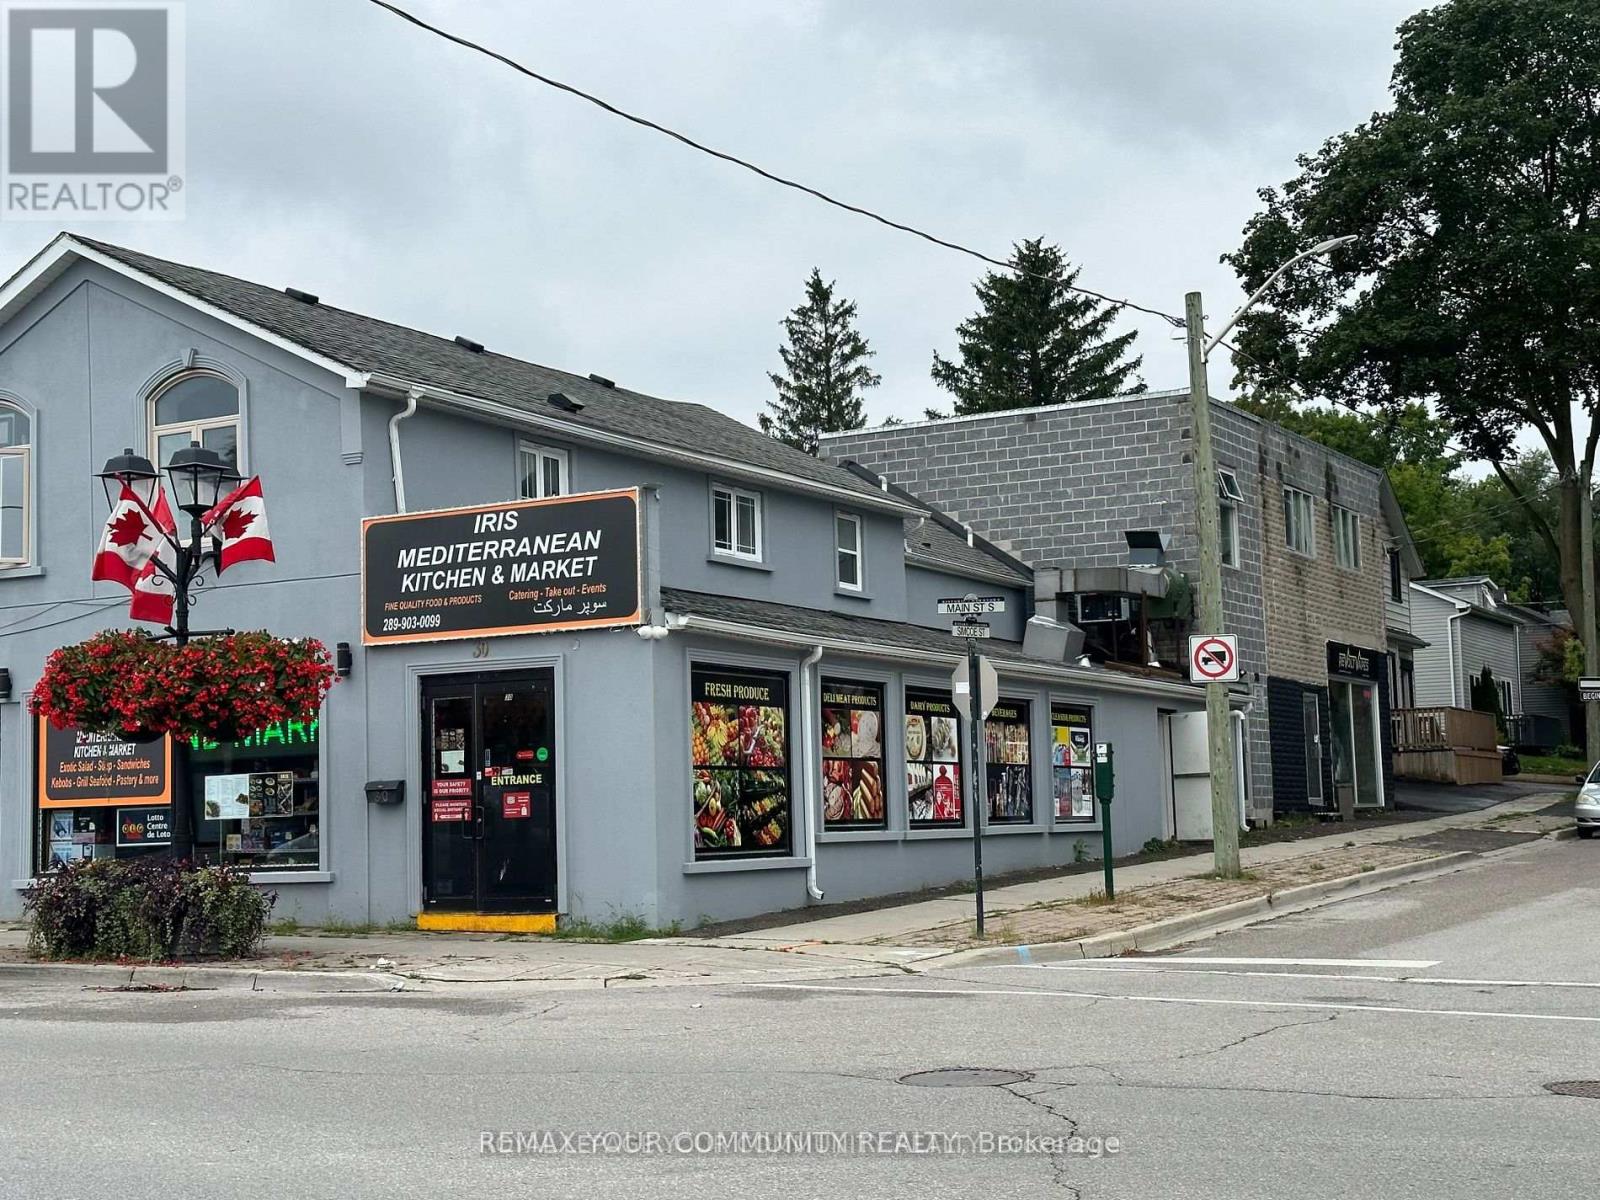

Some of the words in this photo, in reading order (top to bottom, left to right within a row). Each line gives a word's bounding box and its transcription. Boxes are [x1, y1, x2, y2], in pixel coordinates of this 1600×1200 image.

[473, 511, 519, 534] IRIS
[397, 530, 602, 568] MEDITERRANEAN
[401, 566, 486, 593] KITCHEN
[491, 565, 504, 584] &
[510, 556, 598, 583] MARKET
[508, 589, 539, 601] Catering
[545, 586, 562, 597] Take
[563, 586, 576, 595] out
[581, 583, 607, 595] Events
[385, 601, 398, 611] FINE
[399, 600, 424, 610] QUALITY
[425, 598, 442, 608] FOOD
[449, 595, 482, 606] PRODUCTS
[946, 604, 970, 613] MAIN
[972, 603, 985, 612] ST
[988, 602, 995, 612] S
[383, 614, 440, 632] 289-903-0099
[472, 641, 489, 658] 30
[704, 682, 732, 699] FRESH
[733, 685, 770, 701] PRODUCE
[823, 692, 835, 703] DELI
[835, 693, 851, 704] MEAT
[851, 695, 877, 706] PRODUCTS
[910, 700, 926, 711] DAIRY
[926, 703, 950, 713] PRODUCTS
[991, 708, 1017, 719] BEVERAGES
[73, 745, 101, 758] KITCHEN
[60, 762, 77, 773] Exotic
[78, 761, 93, 772] Salad
[117, 759, 151, 770] Sandwiches
[77, 777, 88, 788] Grill
[89, 775, 113, 787] Seafood
[144, 776, 159, 785] more
[491, 774, 543, 786] ENTRANCE
[146, 822, 168, 830] Centre
